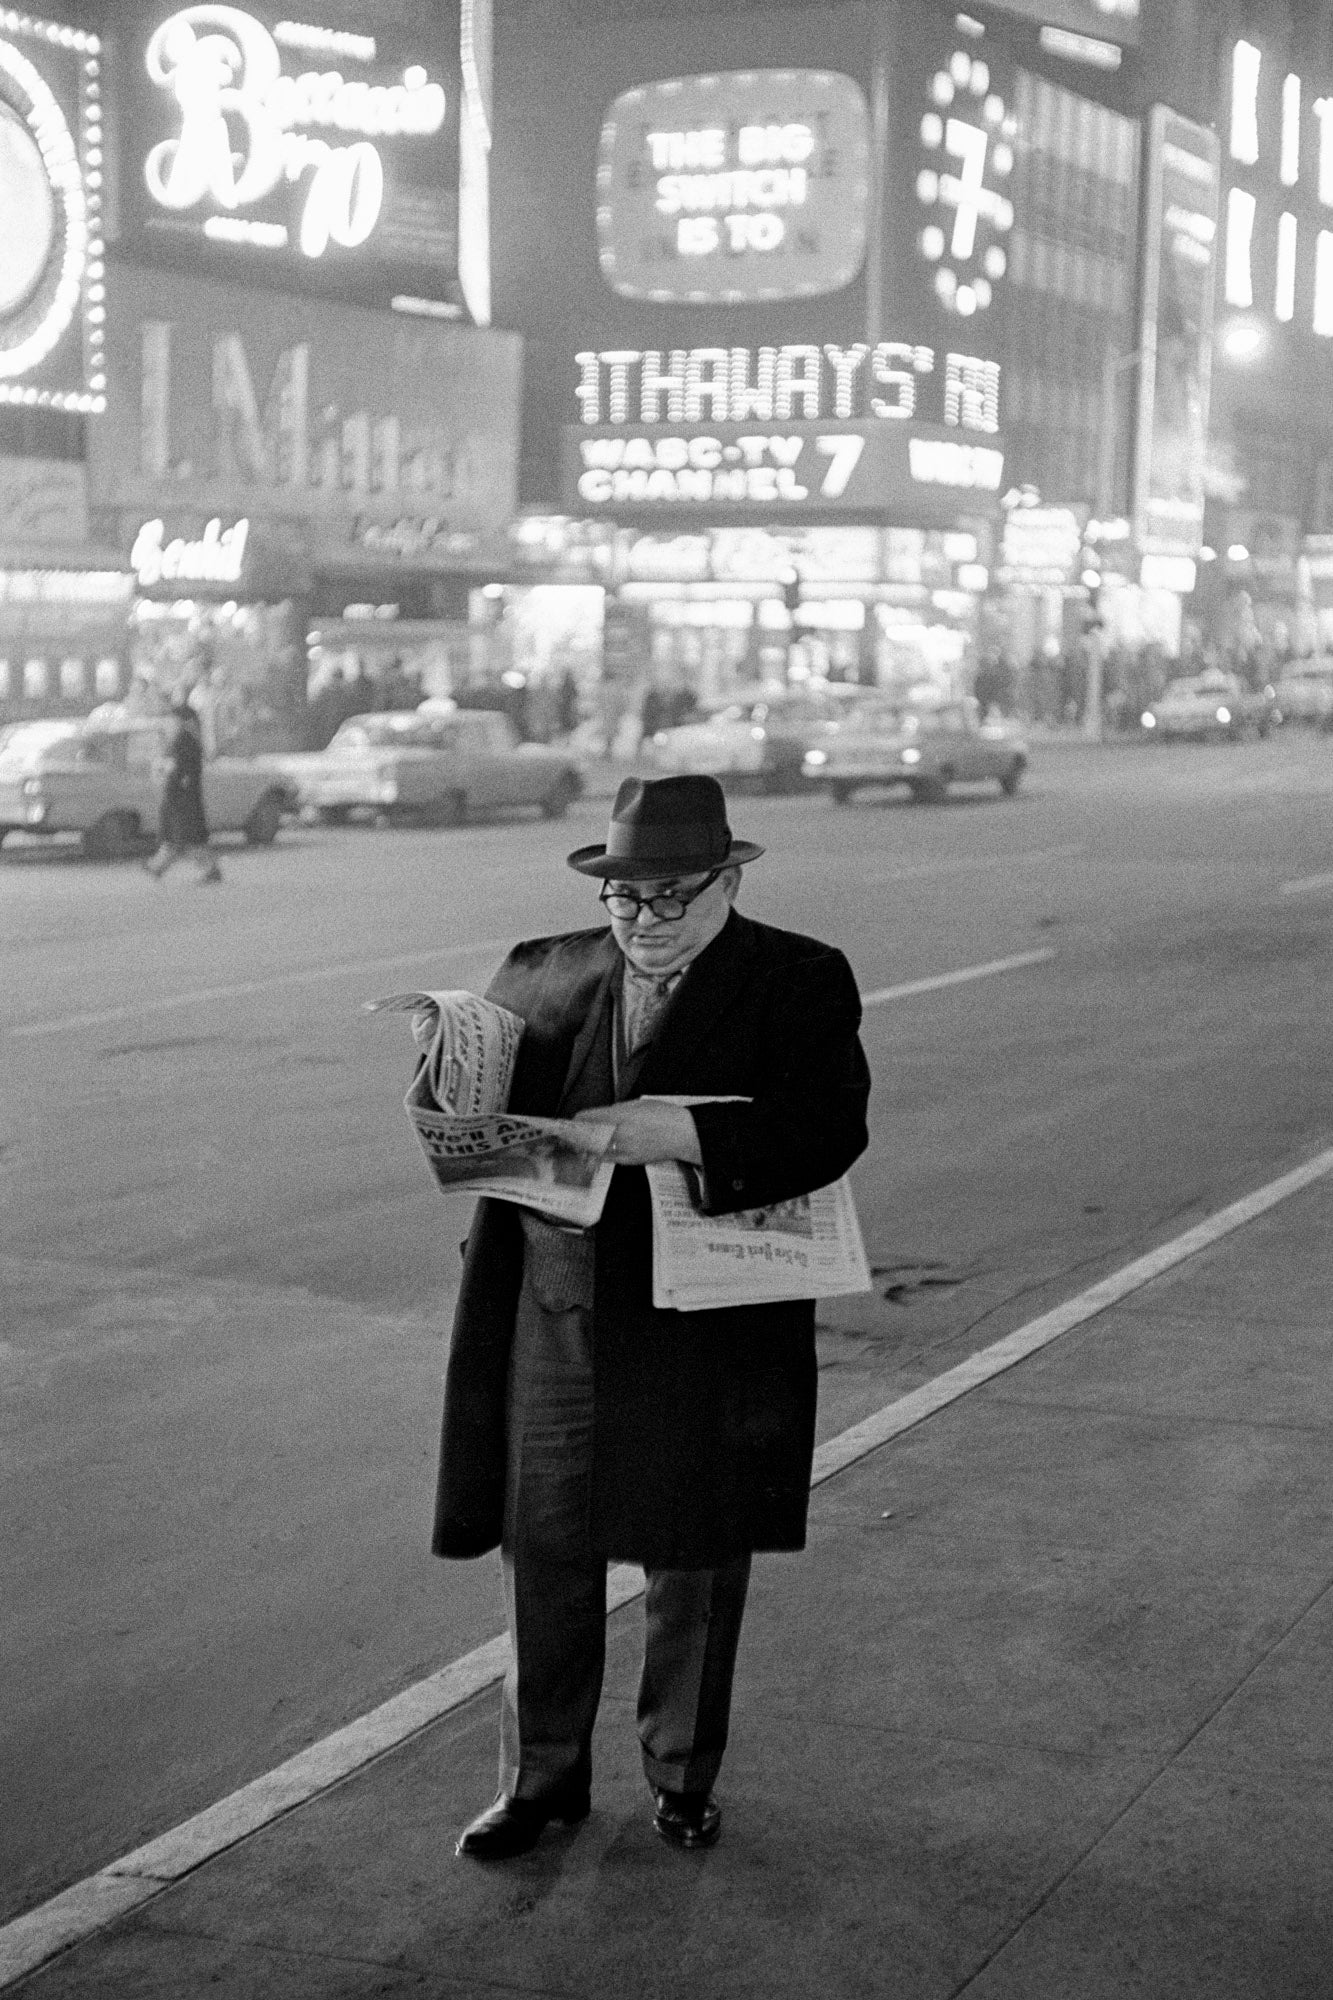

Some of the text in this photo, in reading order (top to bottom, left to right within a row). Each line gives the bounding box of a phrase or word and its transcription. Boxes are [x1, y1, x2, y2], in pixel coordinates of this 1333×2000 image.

[647, 124, 815, 170] THE BIG
[655, 168, 808, 214] SWITCH
[677, 212, 785, 255] IS TO
[579, 468, 808, 502] CHANNEL
[581, 437, 803, 470] WABC-TV
[816, 434, 865, 497] 7
[419, 1127, 485, 1142] We'll
[429, 1141, 492, 1155] THIS
